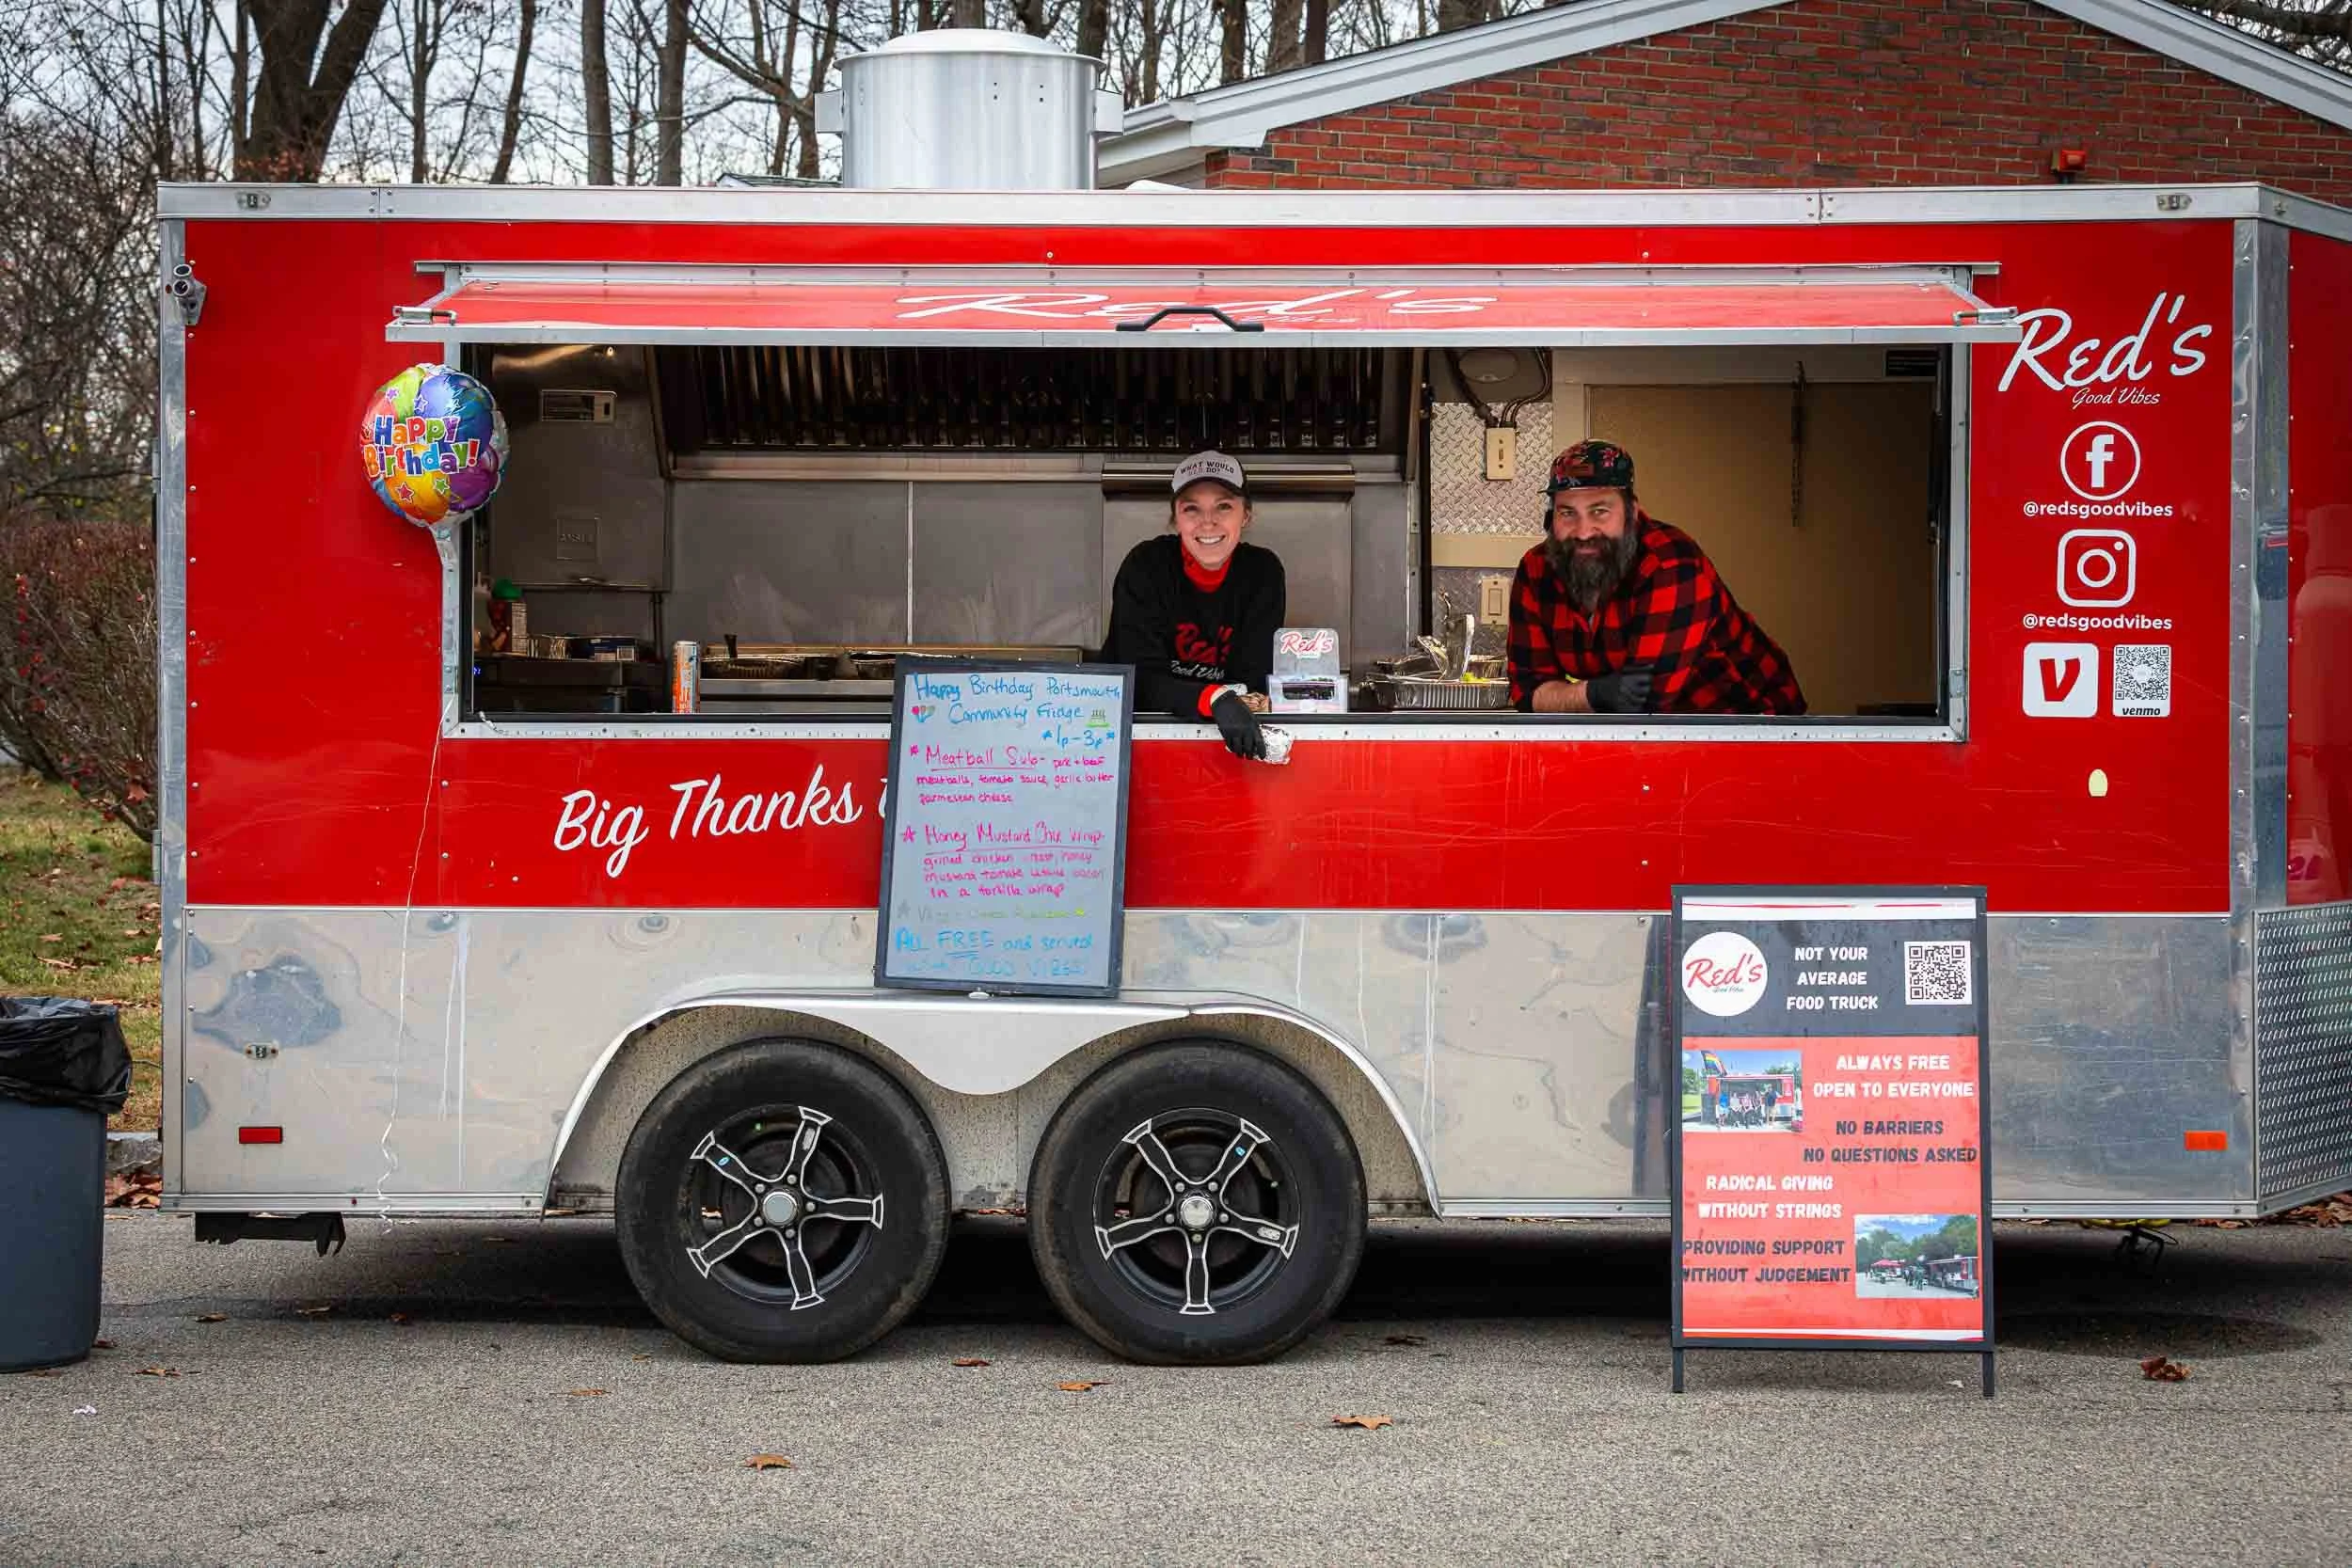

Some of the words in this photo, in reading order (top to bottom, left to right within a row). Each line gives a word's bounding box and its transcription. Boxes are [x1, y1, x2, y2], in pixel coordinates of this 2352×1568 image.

[1998, 292, 2213, 392] Red's
[2072, 387, 2113, 410] Good
[2117, 387, 2161, 405] Vibes
[373, 414, 461, 446] Happy
[363, 438, 481, 478] Birthday!
[1181, 461, 1203, 474] WHAT
[1206, 461, 1234, 474] WOULD
[1206, 467, 1221, 475] DO?
[2023, 500, 2173, 519] @redsgoodvibes
[2023, 612, 2172, 631] @redsgoodvibes
[1280, 631, 1334, 655] Red's
[913, 672, 961, 702] Happy
[970, 674, 1034, 701] Birthday
[948, 703, 1028, 724] Community
[1037, 702, 1084, 723] Fridge
[2122, 706, 2161, 716] venmo
[926, 744, 993, 766] Meatball
[553, 789, 650, 879] Big
[669, 764, 864, 841] Thanks
[925, 824, 967, 851] Honey
[977, 822, 1031, 843] Mustard
[937, 929, 994, 948] FREE
[1001, 933, 1032, 950] and
[1795, 947, 1824, 961] NOT
[1829, 947, 1867, 960] YOUR
[1686, 953, 1763, 988] Red's
[1797, 972, 1867, 986] AVERAGE
[1787, 996, 1824, 1010] FOOD
[1829, 996, 1879, 1010] TRUCK
[1836, 1054, 1902, 1070] ALWAYS
[1908, 1054, 1950, 1069] FREE
[1813, 1082, 1856, 1097] OPEN
[1861, 1083, 1883, 1097] TO
[1888, 1082, 1974, 1097] EVERYONE
[1836, 1120, 1857, 1135] NO
[1864, 1120, 1944, 1135] BARRIERS
[1804, 1148, 1824, 1163] NO
[1831, 1148, 1918, 1163] QUESTIONS
[1924, 1148, 1978, 1163] ASKED
[1706, 1176, 1776, 1190] RADICAL
[1781, 1176, 1834, 1190] GIVING
[1698, 1203, 1769, 1218] WITHOUT
[1775, 1203, 1842, 1218] STRINGS
[1682, 1241, 1766, 1255] PROVIDING
[1772, 1241, 1845, 1255] SUPPORT
[1755, 1267, 1851, 1282] JUDGEMENT
